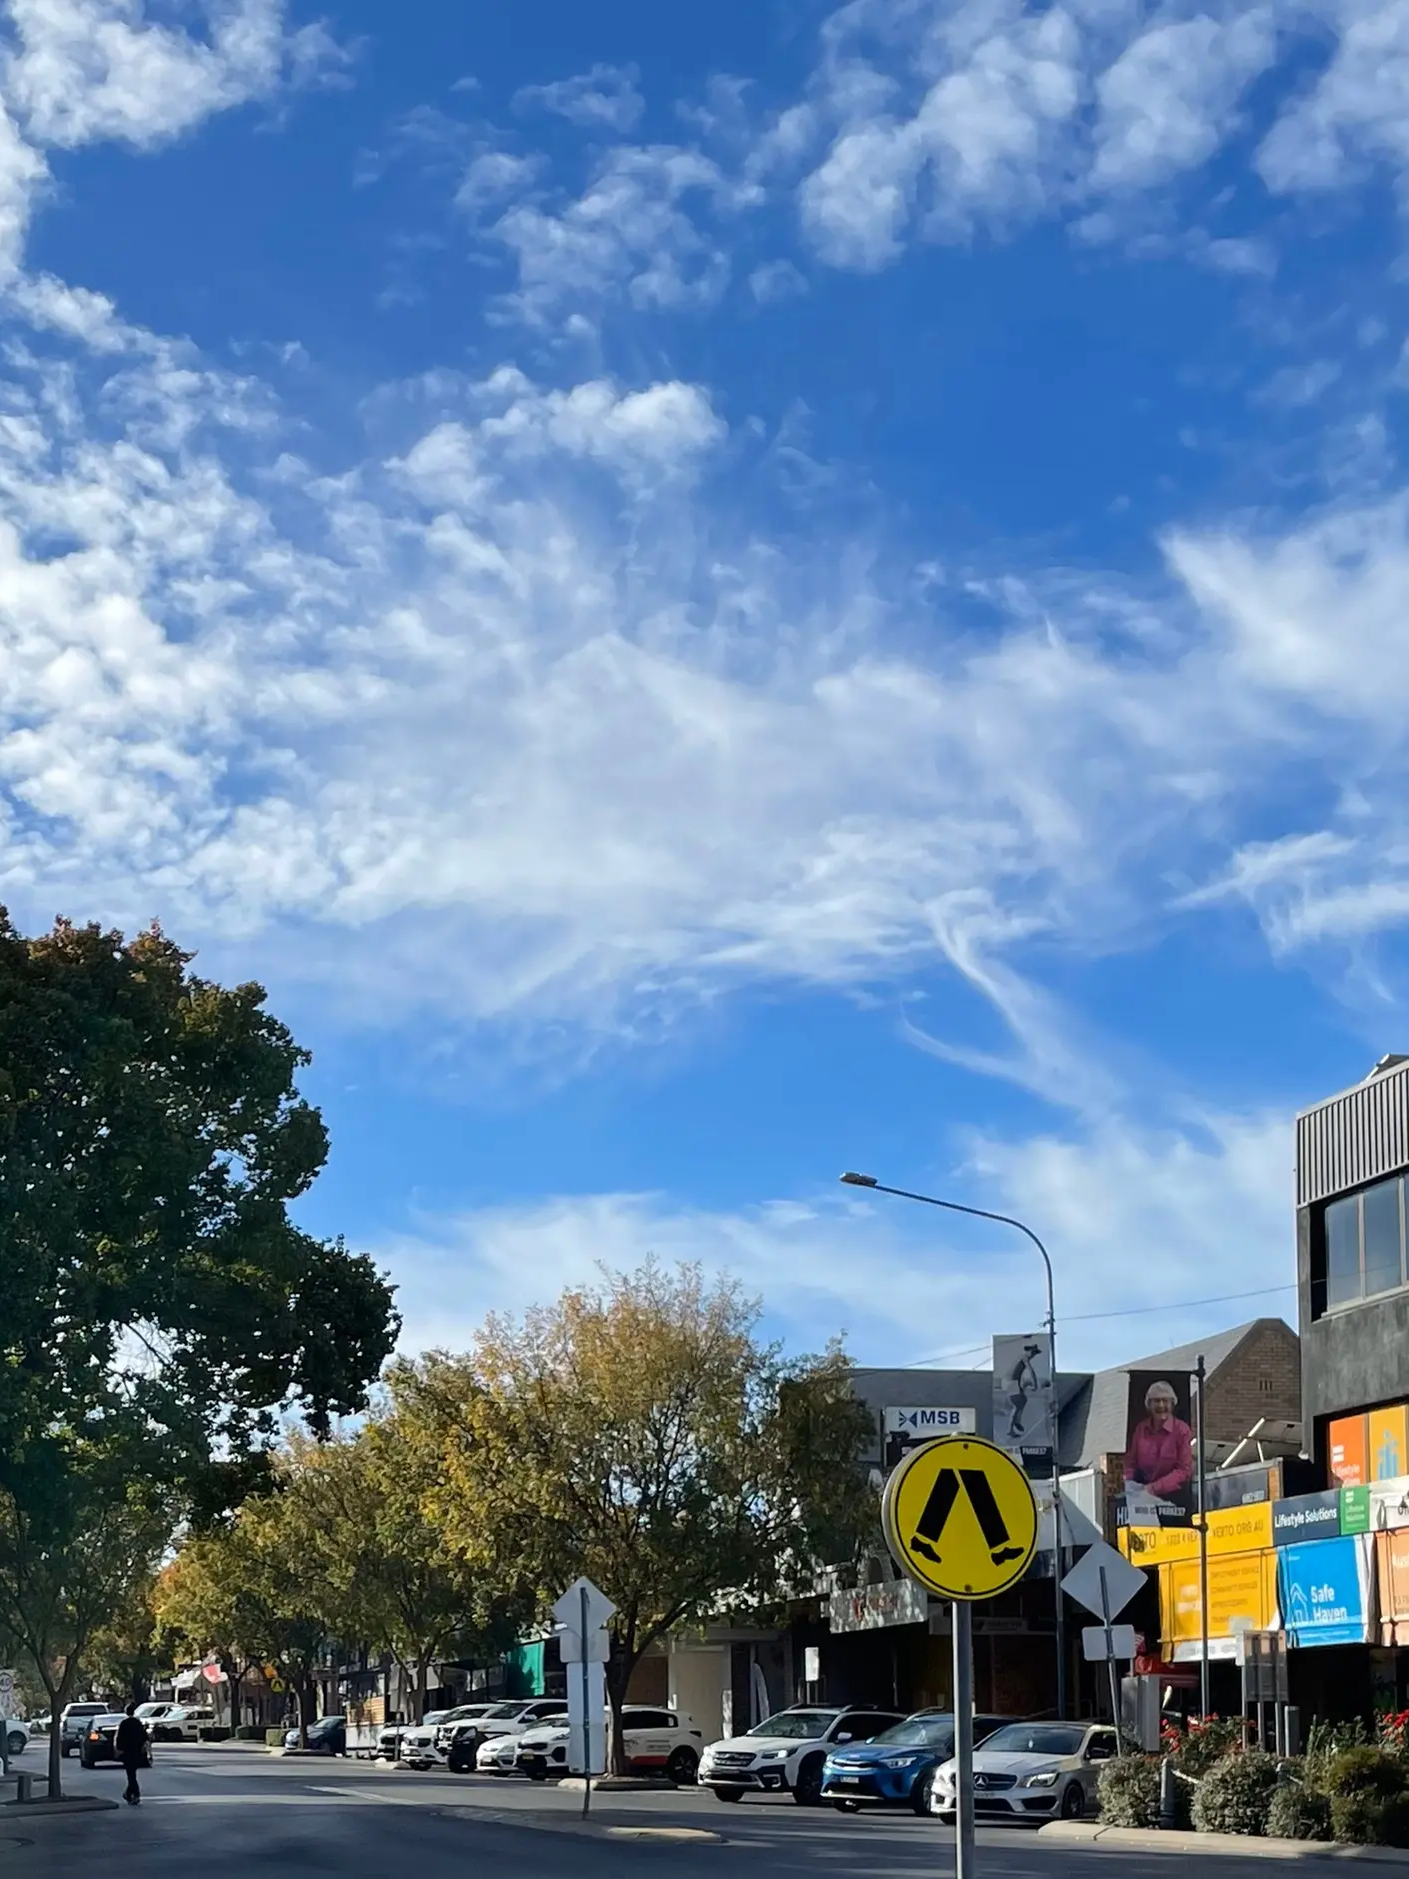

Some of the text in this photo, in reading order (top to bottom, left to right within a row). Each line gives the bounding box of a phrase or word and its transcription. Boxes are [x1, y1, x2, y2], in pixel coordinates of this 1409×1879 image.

[921, 1411, 960, 1425] MSB
[1274, 1510, 1304, 1528] Lifestyle
[1305, 1507, 1337, 1523] Solutions
[1310, 1583, 1335, 1604] Safe
[1313, 1606, 1347, 1622] Haven
[0, 1677, 11, 1687] 40
